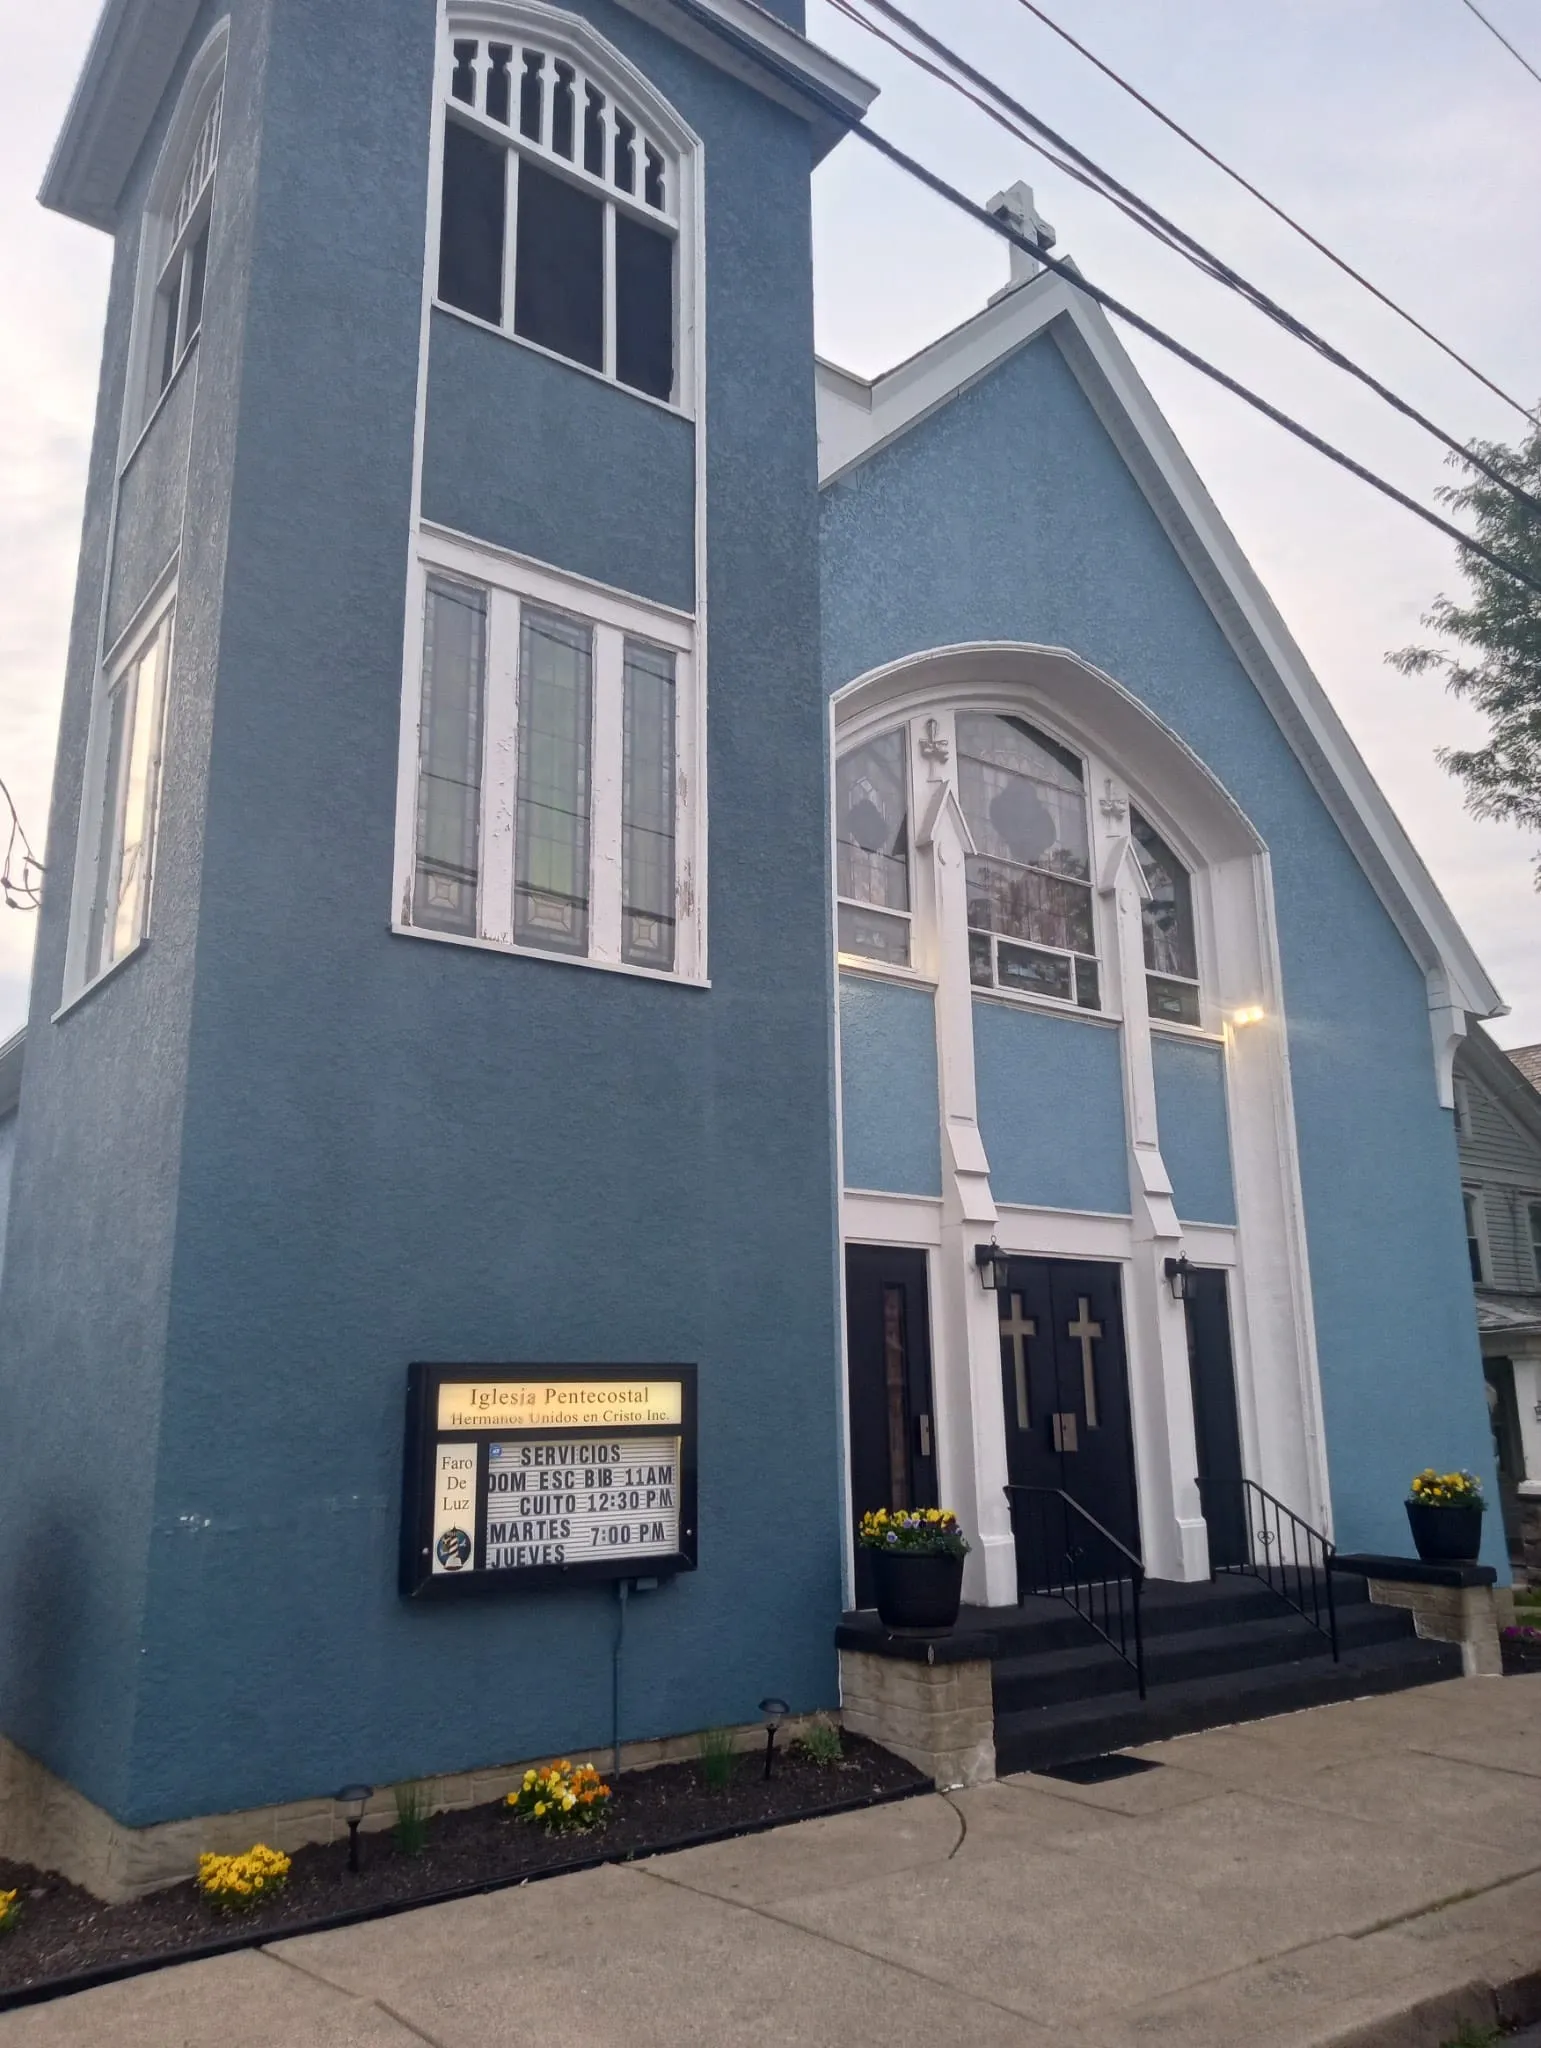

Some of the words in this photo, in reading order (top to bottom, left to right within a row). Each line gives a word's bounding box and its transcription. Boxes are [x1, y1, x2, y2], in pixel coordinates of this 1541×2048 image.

[471, 1387, 536, 1410] Iglesia
[545, 1386, 648, 1405] Pentecostal
[452, 1411, 524, 1425] Hermanos
[529, 1411, 578, 1424] Unidos
[583, 1414, 598, 1423] en
[603, 1410, 642, 1422] Cristo
[647, 1409, 670, 1421] Inc.
[441, 1456, 473, 1470] Faro
[521, 1444, 620, 1466] SERVICIOS
[447, 1476, 467, 1490] De
[489, 1472, 526, 1493] DOM
[540, 1470, 574, 1490] ESC
[585, 1468, 613, 1488] BIB
[625, 1466, 671, 1486] 11AM
[443, 1497, 470, 1511] Luz
[588, 1491, 639, 1512] 12:30
[646, 1488, 672, 1508] PM
[490, 1519, 571, 1544] MARTES
[591, 1525, 630, 1547] 7:00
[640, 1521, 665, 1542] PM
[491, 1544, 565, 1569] JUEVES
